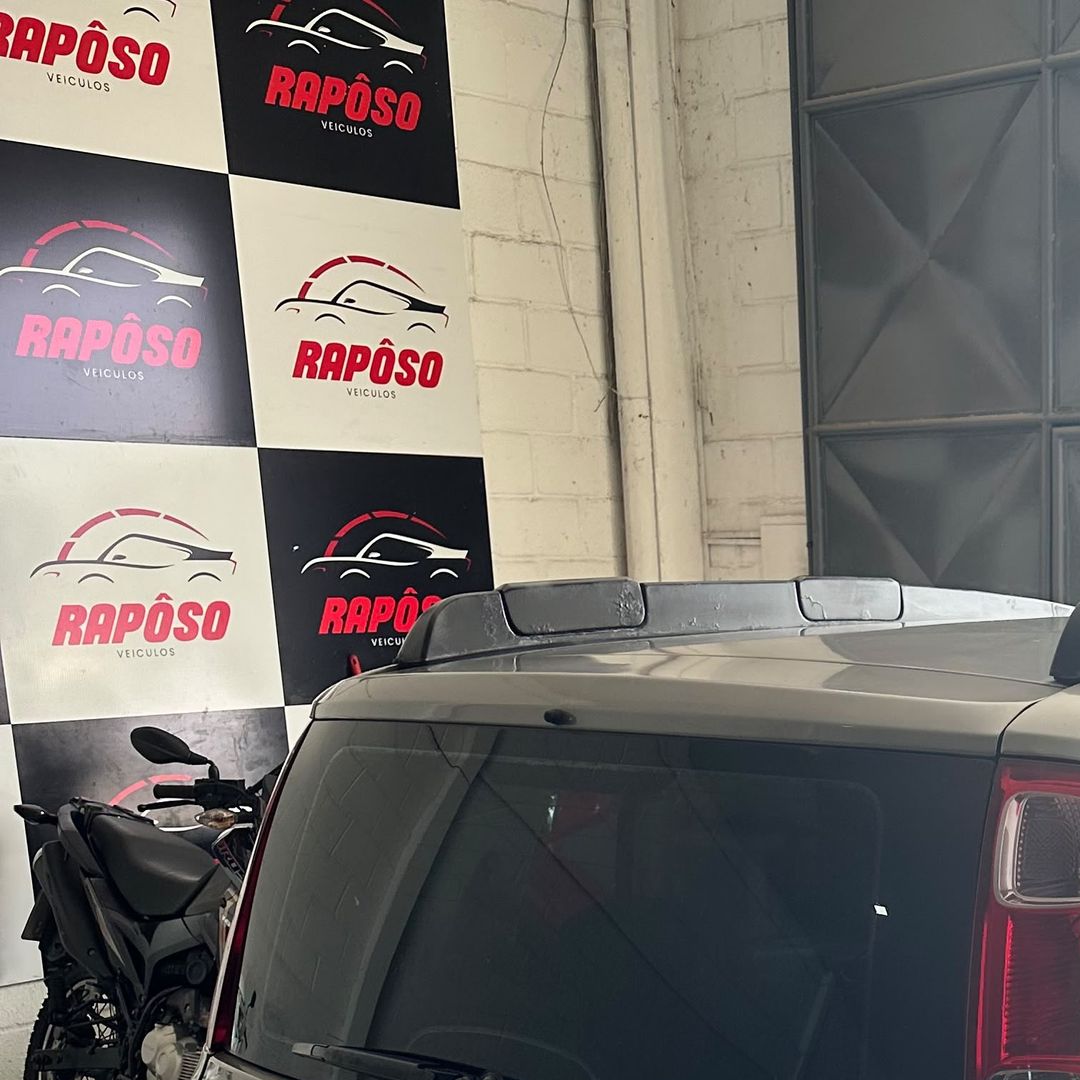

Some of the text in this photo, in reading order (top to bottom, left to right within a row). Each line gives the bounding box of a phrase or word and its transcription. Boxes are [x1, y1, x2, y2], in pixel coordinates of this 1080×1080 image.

[46, 72, 111, 92] VEICULOS
[265, 65, 422, 131] RAPÔSO
[320, 119, 374, 138] VEICULOS
[15, 313, 203, 369] RAPÔSO
[292, 338, 444, 389] RAPÔSO
[83, 367, 145, 381] VEICULOS
[346, 387, 397, 399] VEICULOS
[51, 593, 231, 646] RAPÔSO
[318, 587, 443, 634] RAPÔ
[371, 637, 406, 647] VEICU
[116, 647, 175, 659] VEICULOS
